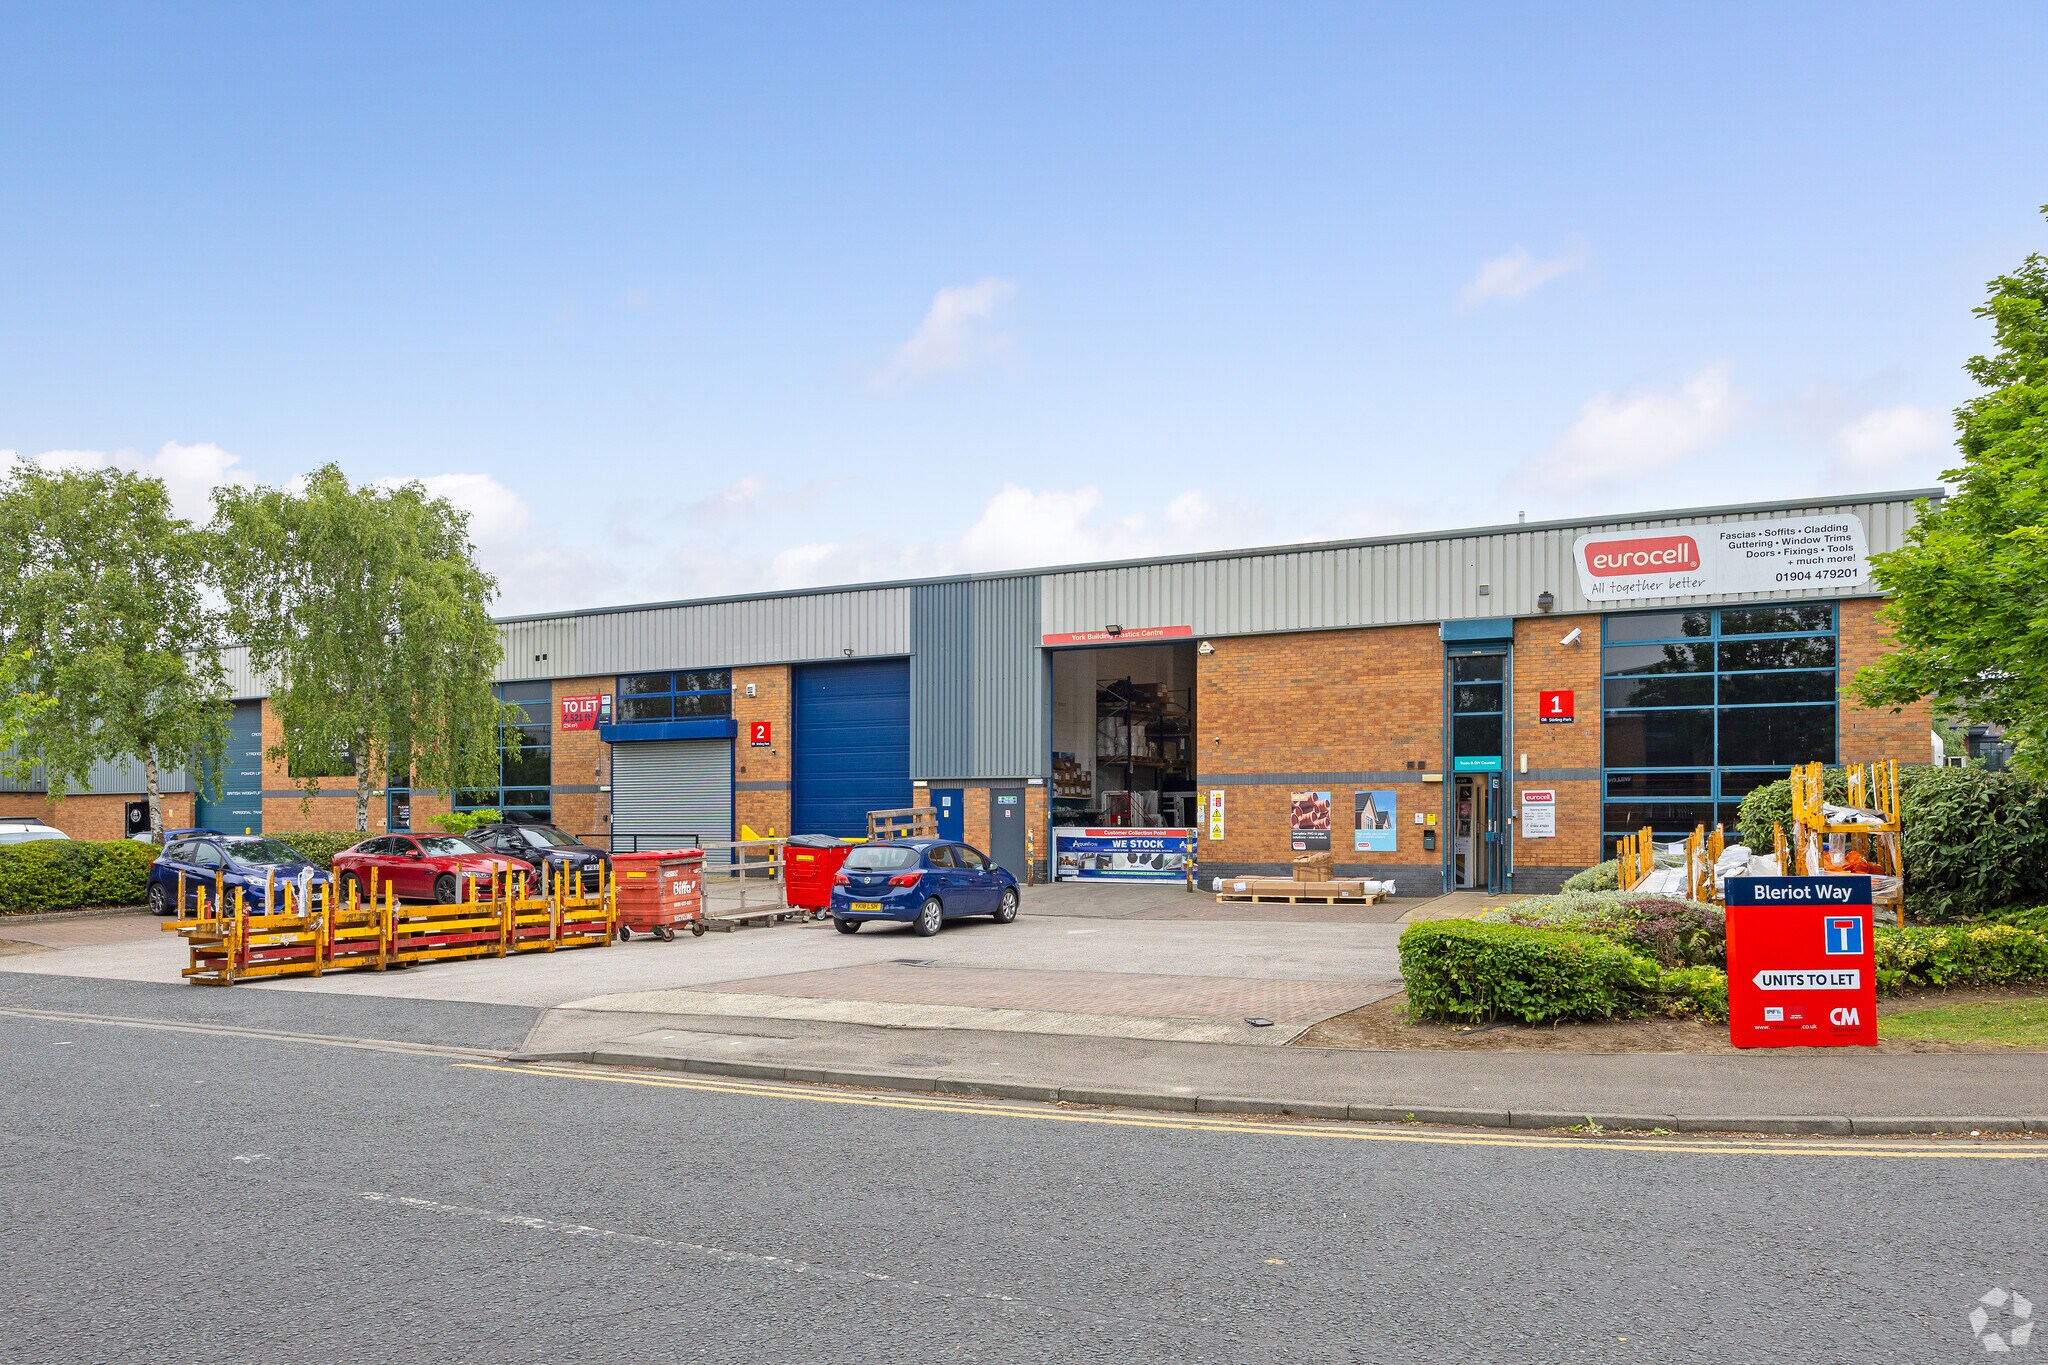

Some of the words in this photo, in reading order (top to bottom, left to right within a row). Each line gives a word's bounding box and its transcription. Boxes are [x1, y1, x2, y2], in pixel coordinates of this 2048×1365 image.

[1720, 530, 1756, 540] Fascias
[1764, 527, 1796, 537] Soffits
[1804, 524, 1848, 534] Cladding
[1728, 539, 1773, 549] Guttering
[1781, 536, 1821, 545] Window
[1824, 534, 1852, 542] Trims
[1593, 542, 1689, 568] eurocell
[1746, 550, 1775, 558] Doors
[1784, 546, 1819, 556] Fixings
[1827, 544, 1854, 552] Tools
[1797, 556, 1824, 565] much
[1827, 554, 1856, 563] more!
[1776, 571, 1811, 582] 01904
[1815, 568, 1858, 579] 479201
[1592, 582, 1605, 594] All
[1610, 579, 1664, 594] together
[1669, 577, 1706, 589] better
[1088, 632, 1113, 640] Building
[563, 701, 578, 713] TO
[580, 700, 598, 712] LET
[1551, 696, 1562, 713] 1
[564, 714, 582, 722] 2,521
[757, 726, 764, 738] 2
[1130, 840, 1164, 848] STOCK
[673, 881, 692, 896] Biffa
[1754, 885, 1811, 900] Bleriot
[1815, 884, 1852, 902] Way
[1762, 975, 1804, 986] UNITS
[1807, 974, 1827, 985] TO
[1831, 974, 1854, 985] LET
[1829, 1007, 1860, 1026] CM
